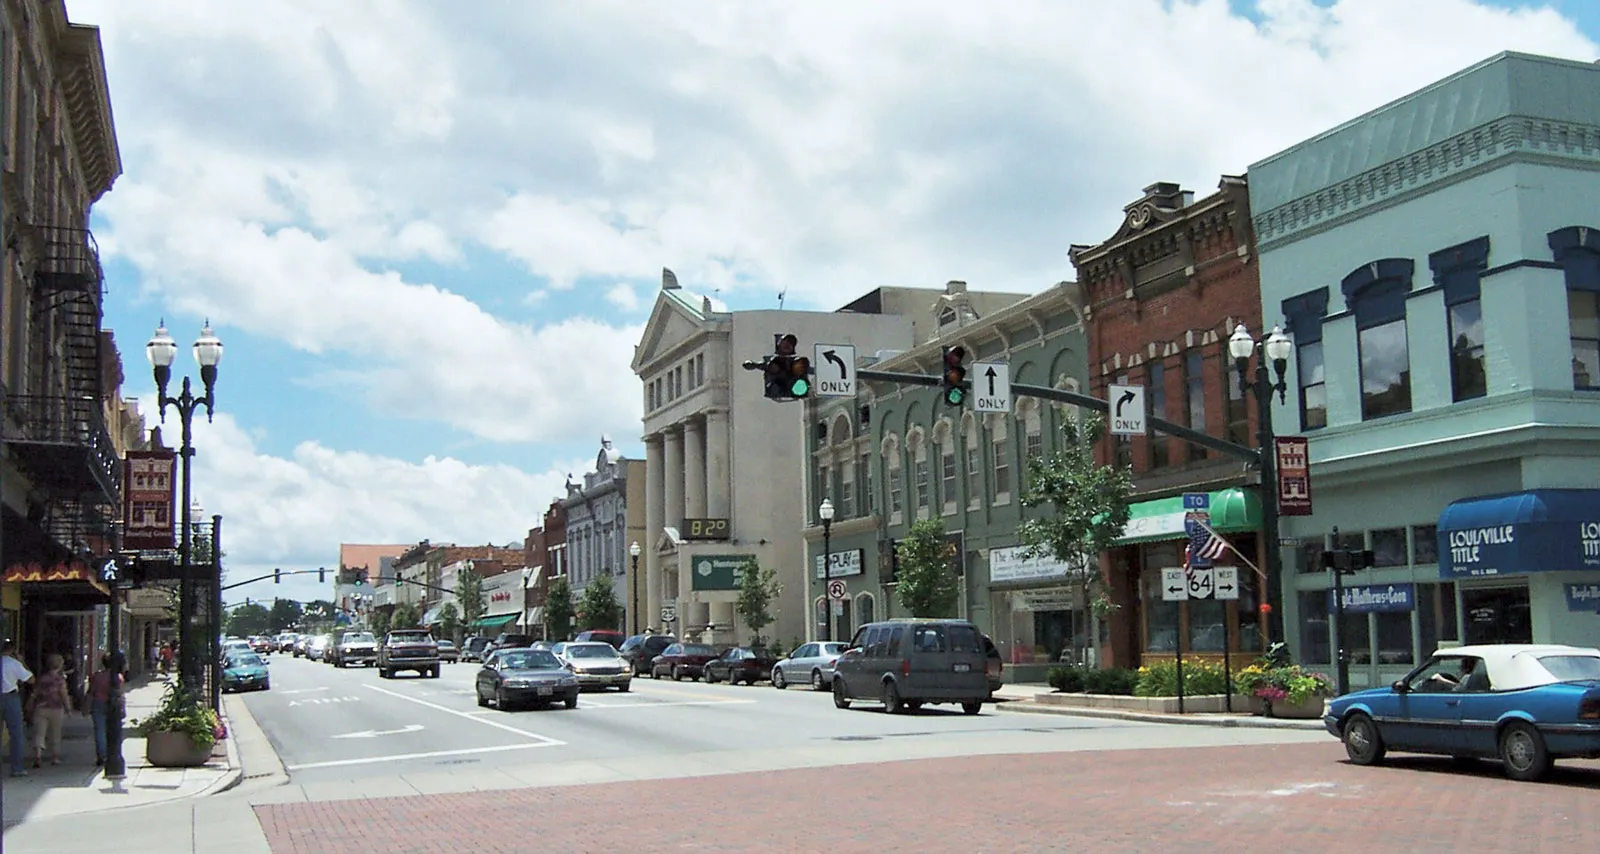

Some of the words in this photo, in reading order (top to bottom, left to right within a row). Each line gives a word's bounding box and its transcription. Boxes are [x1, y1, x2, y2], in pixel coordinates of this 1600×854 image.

[821, 381, 851, 393] ONLY
[978, 398, 1006, 409] ONLY
[1115, 419, 1141, 431] ONLY
[1189, 496, 1204, 506] TO
[126, 530, 152, 538] Bowling
[1450, 525, 1514, 547] LOUISVILLE
[1451, 546, 1480, 563] TITLE
[1167, 571, 1181, 580] EAST
[1218, 570, 1233, 579] WEST
[1190, 574, 1210, 592] 64
[662, 610, 674, 619] 25
